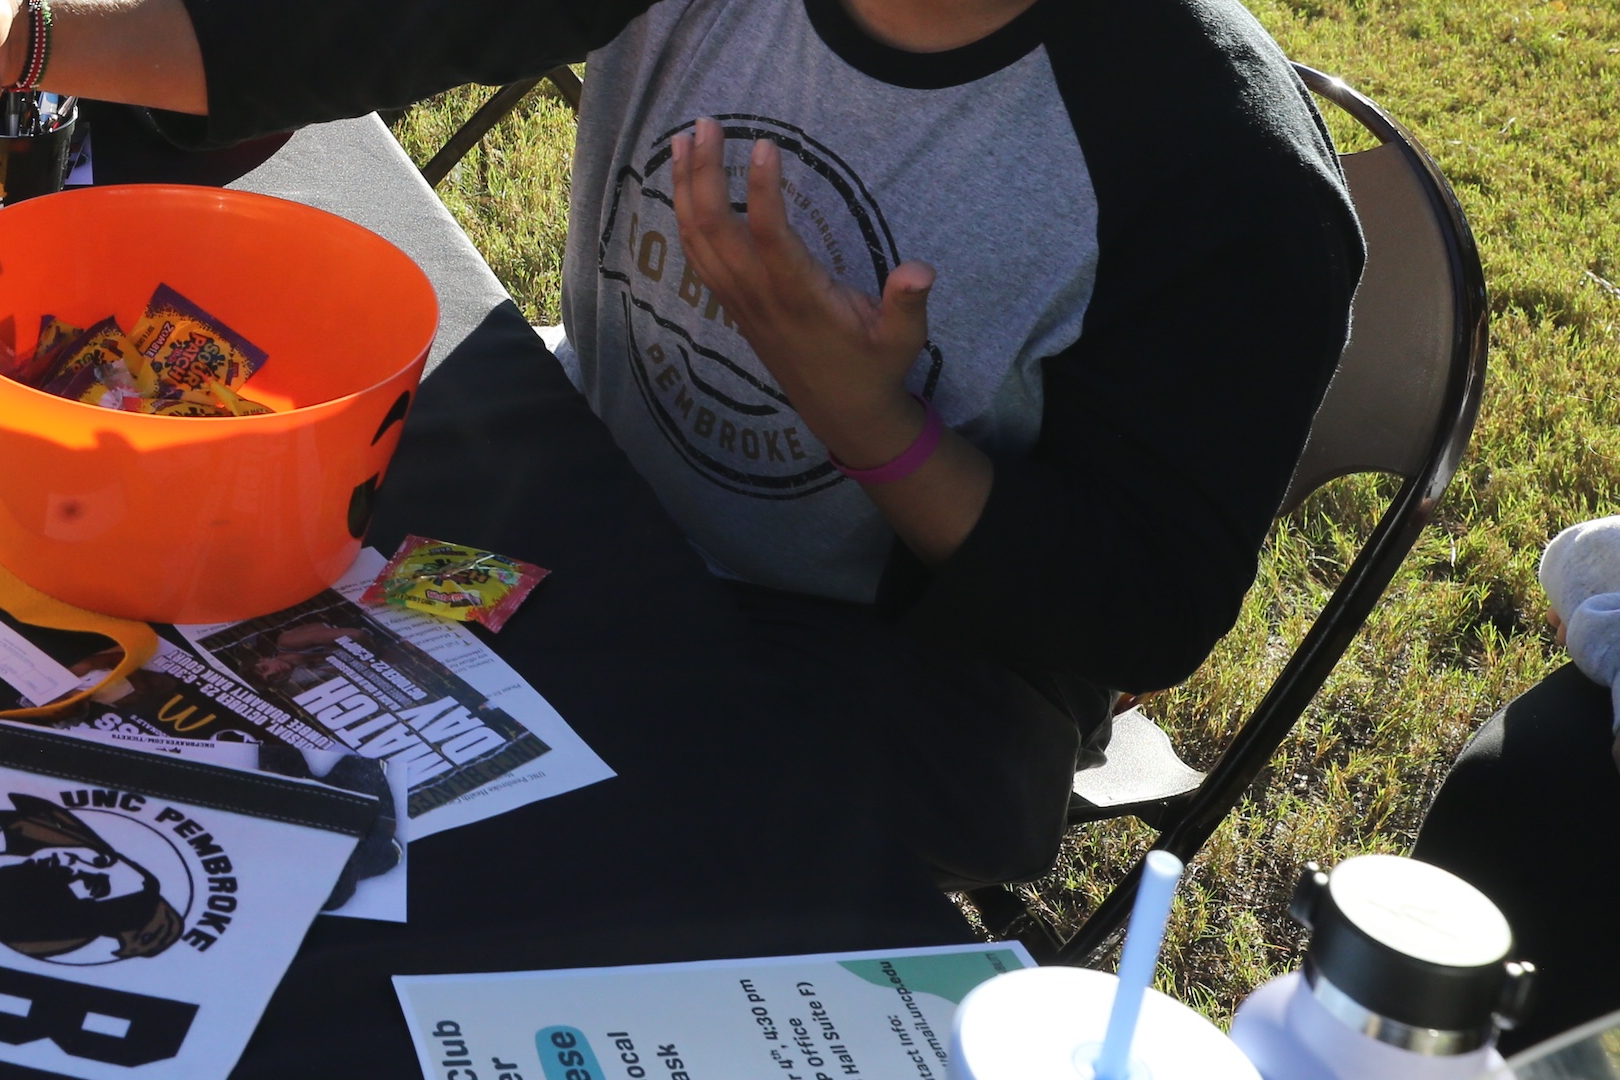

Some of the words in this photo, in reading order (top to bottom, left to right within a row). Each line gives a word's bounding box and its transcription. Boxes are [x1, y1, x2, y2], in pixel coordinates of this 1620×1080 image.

[145, 321, 174, 359] ZOMBIE
[166, 331, 208, 383] PATCH
[181, 340, 221, 388] SOUR
[645, 342, 808, 465] PEMBROKE
[164, 647, 206, 675] COURT
[333, 632, 374, 661] 6:30PM
[152, 652, 198, 685] 6:30PM
[201, 668, 234, 692] BANK
[371, 658, 391, 674] 22
[198, 681, 221, 698] 23
[382, 667, 428, 702] OCTOBER
[213, 689, 269, 727] OCTOBER
[231, 684, 292, 724] GUARANTY
[263, 718, 315, 751] URSDAY,
[285, 717, 335, 751] LUMBEE
[291, 672, 454, 787] MATCH
[395, 693, 507, 769] DAY
[59, 789, 147, 812] UNC
[154, 806, 239, 953] PEMBROKE
[739, 978, 766, 1004] pm
[796, 981, 817, 996] F)
[751, 1005, 780, 1041] 4:30
[809, 1000, 841, 1042] Suite
[886, 1014, 916, 1047] Info:
[606, 1031, 646, 1080] ocal
[789, 1017, 825, 1068] Office
[828, 1045, 861, 1076] Hall
[905, 1049, 937, 1080] tact
